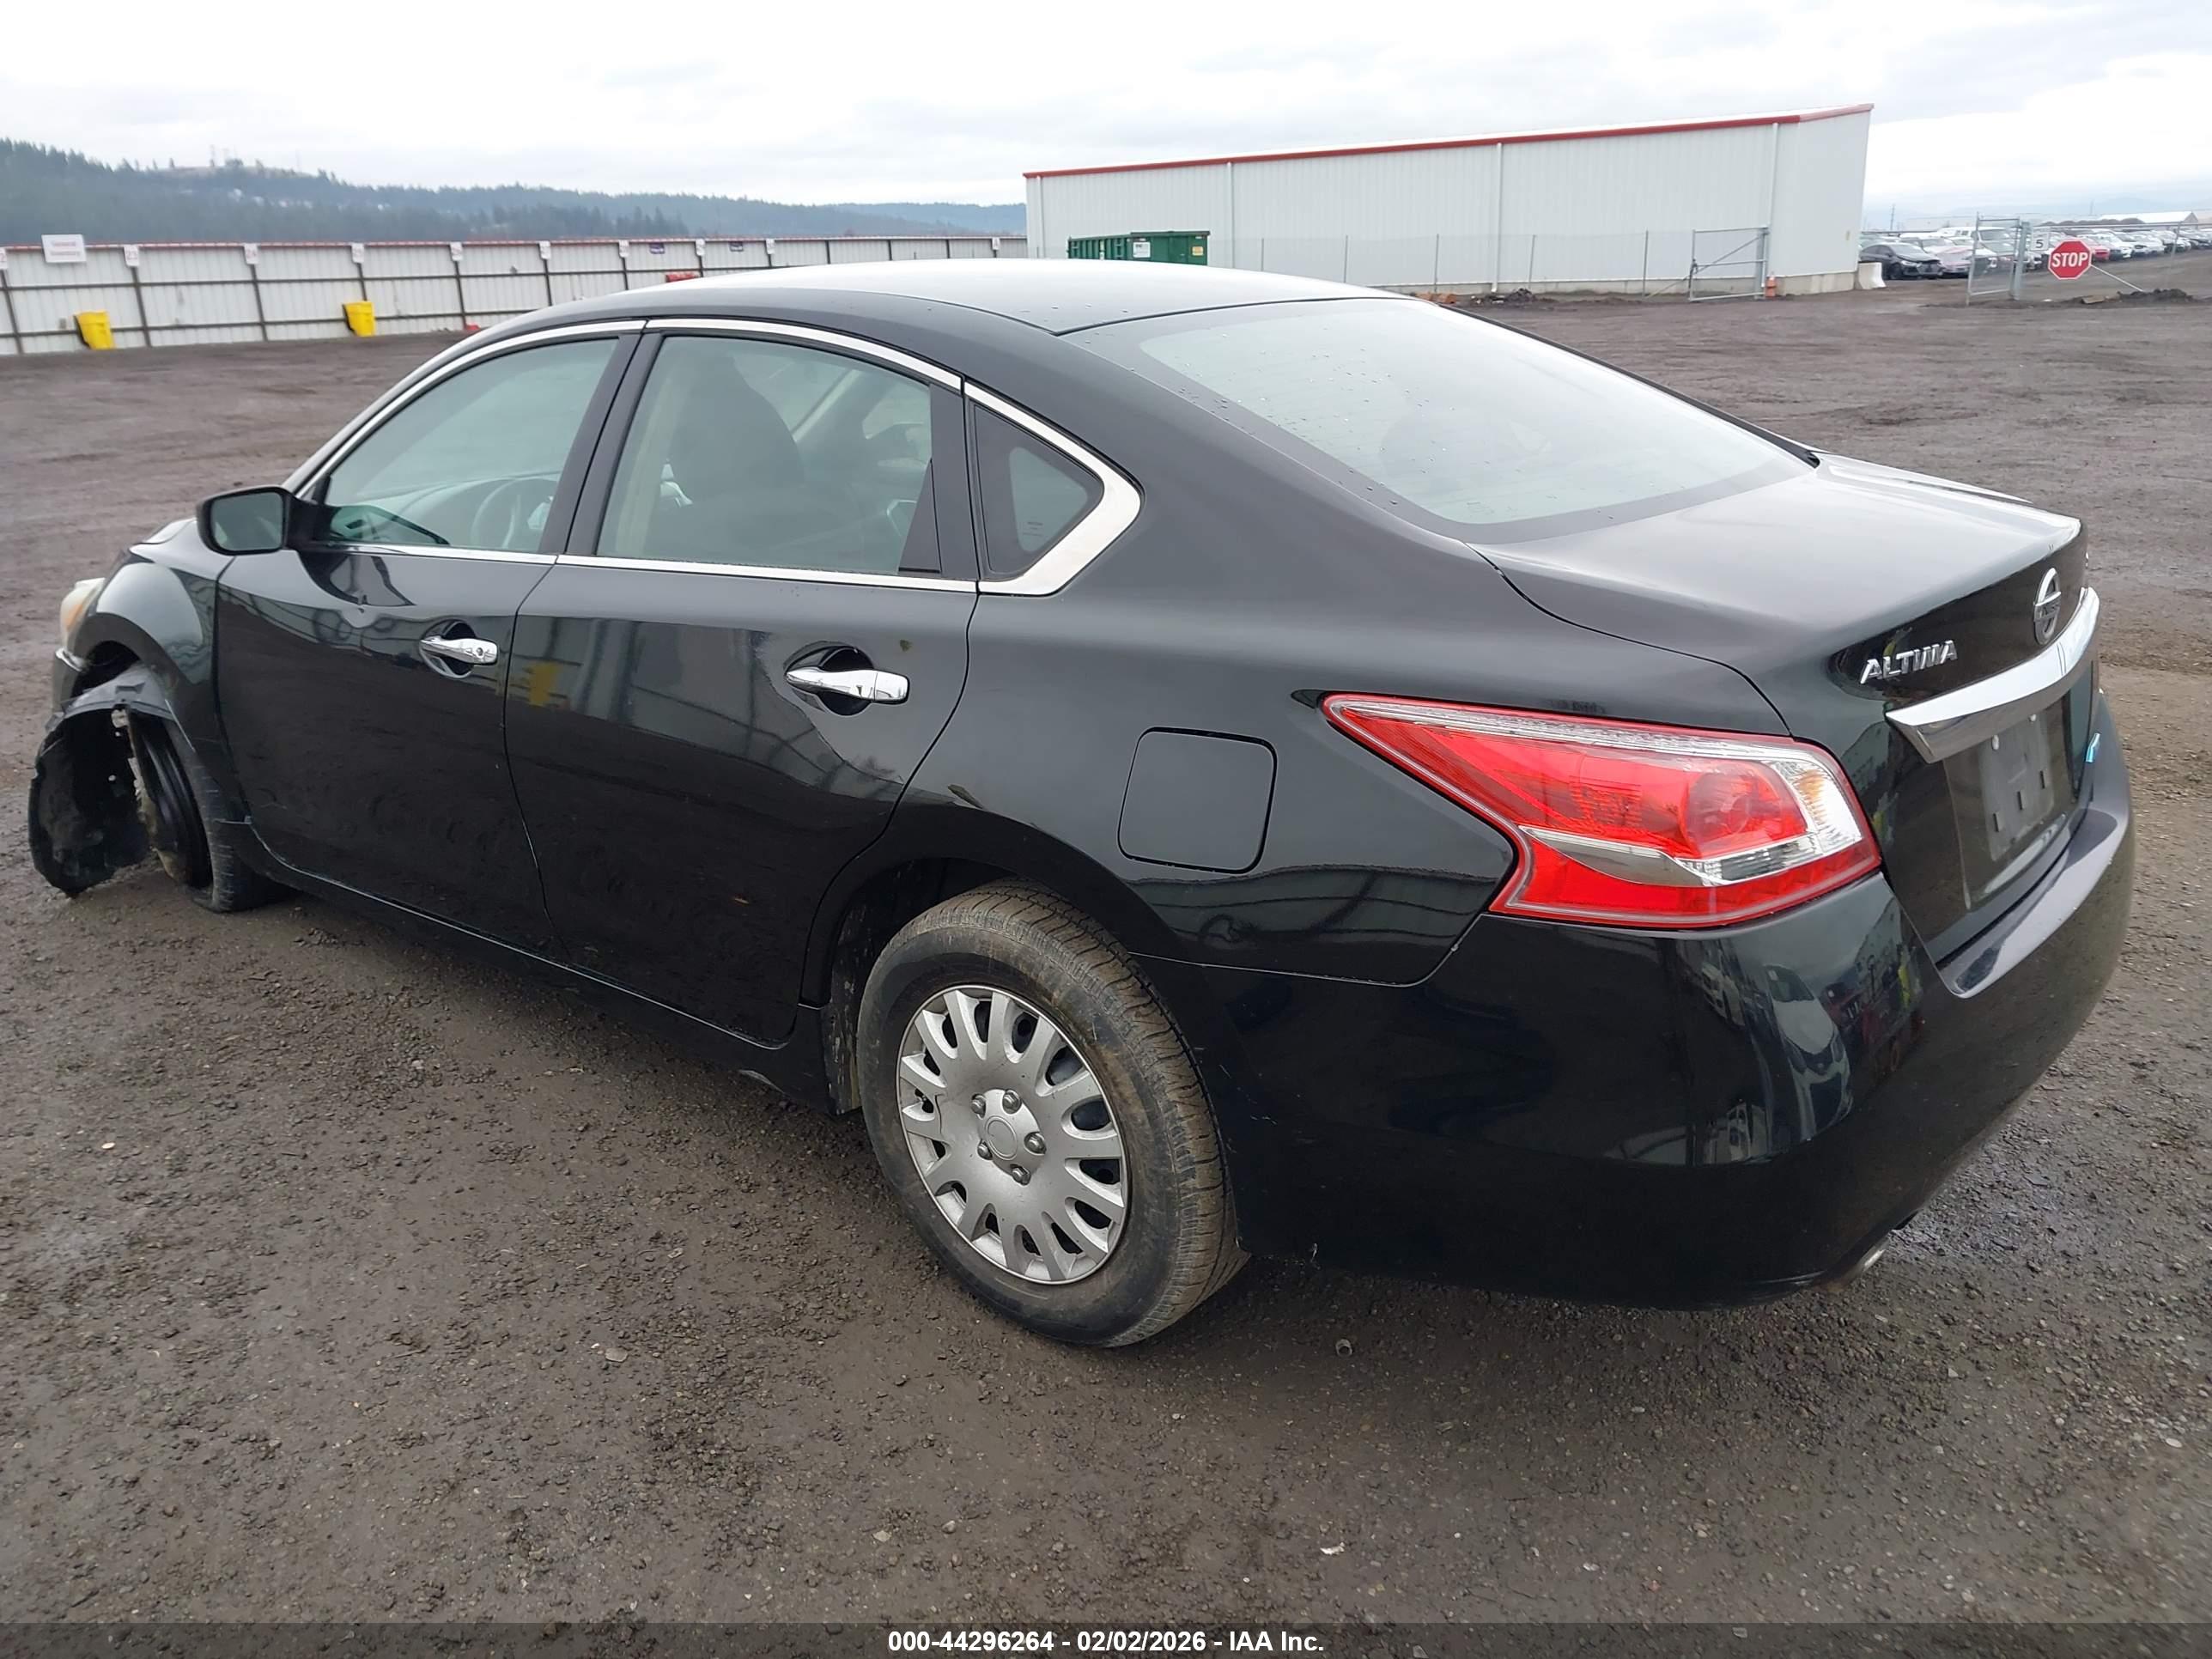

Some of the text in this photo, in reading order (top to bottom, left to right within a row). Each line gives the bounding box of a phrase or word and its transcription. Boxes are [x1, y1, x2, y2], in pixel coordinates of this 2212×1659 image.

[2035, 239, 2044, 249] 5
[2051, 252, 2088, 268] STOP
[1860, 639, 1958, 684] ALTIMA
